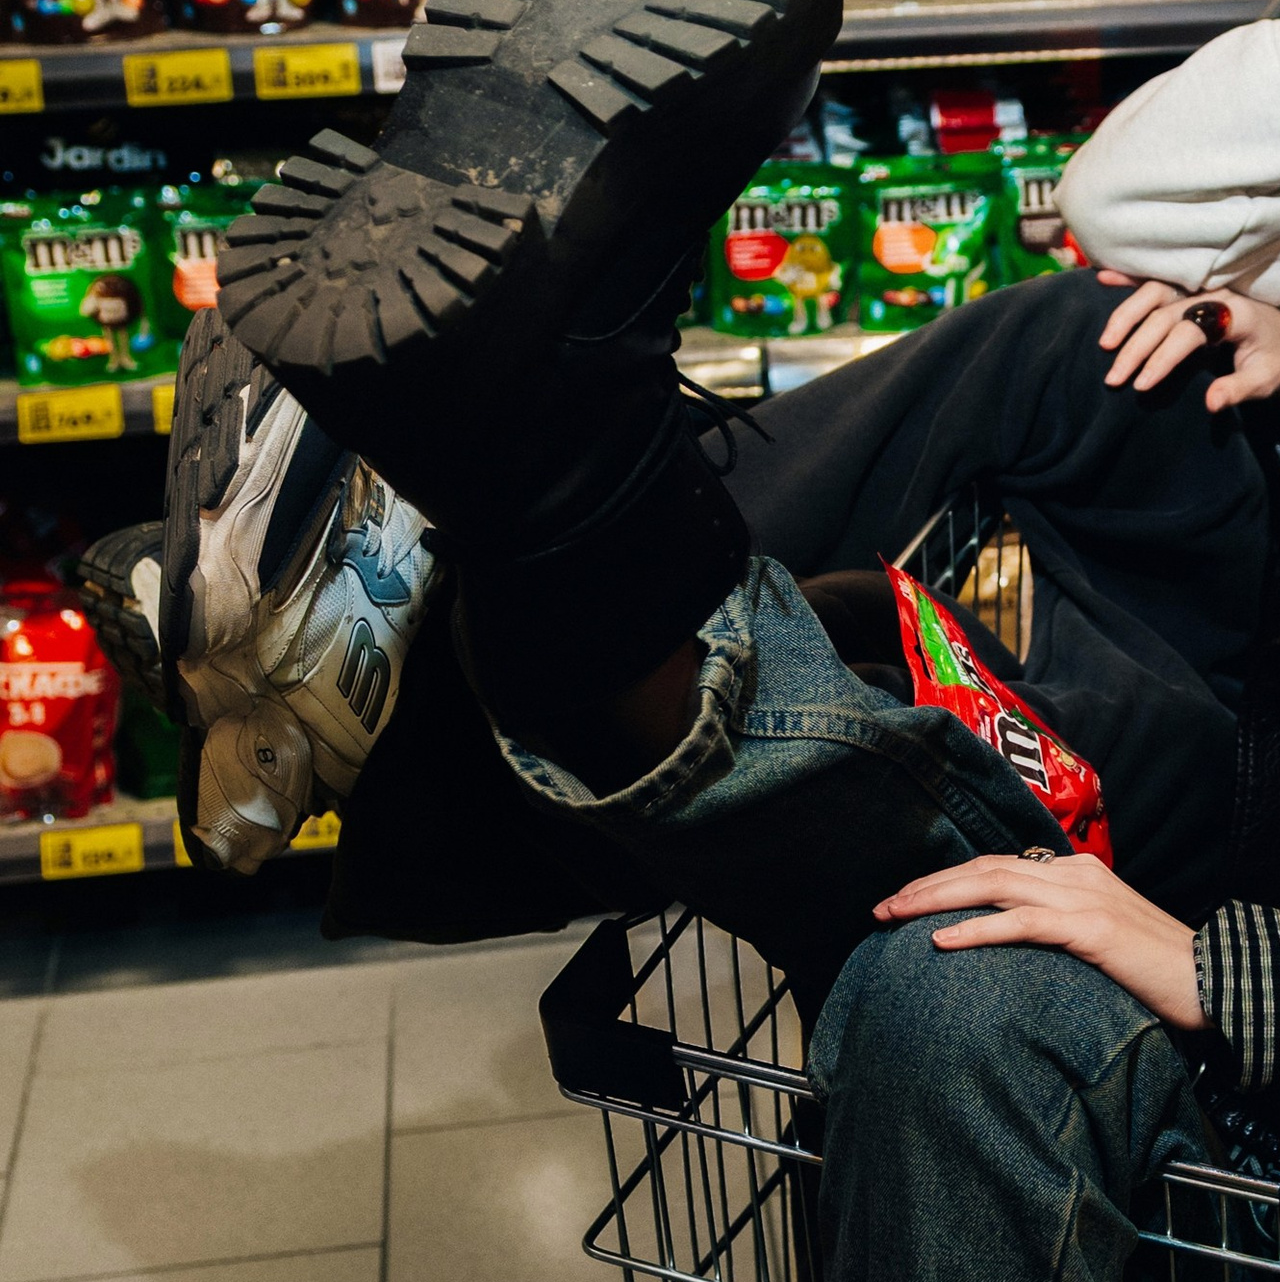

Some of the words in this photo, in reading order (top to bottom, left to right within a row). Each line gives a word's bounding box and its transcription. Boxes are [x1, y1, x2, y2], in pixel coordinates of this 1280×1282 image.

[41, 135, 167, 173] Jardin
[728, 198, 841, 235] m&m's
[23, 227, 141, 275] m&m's
